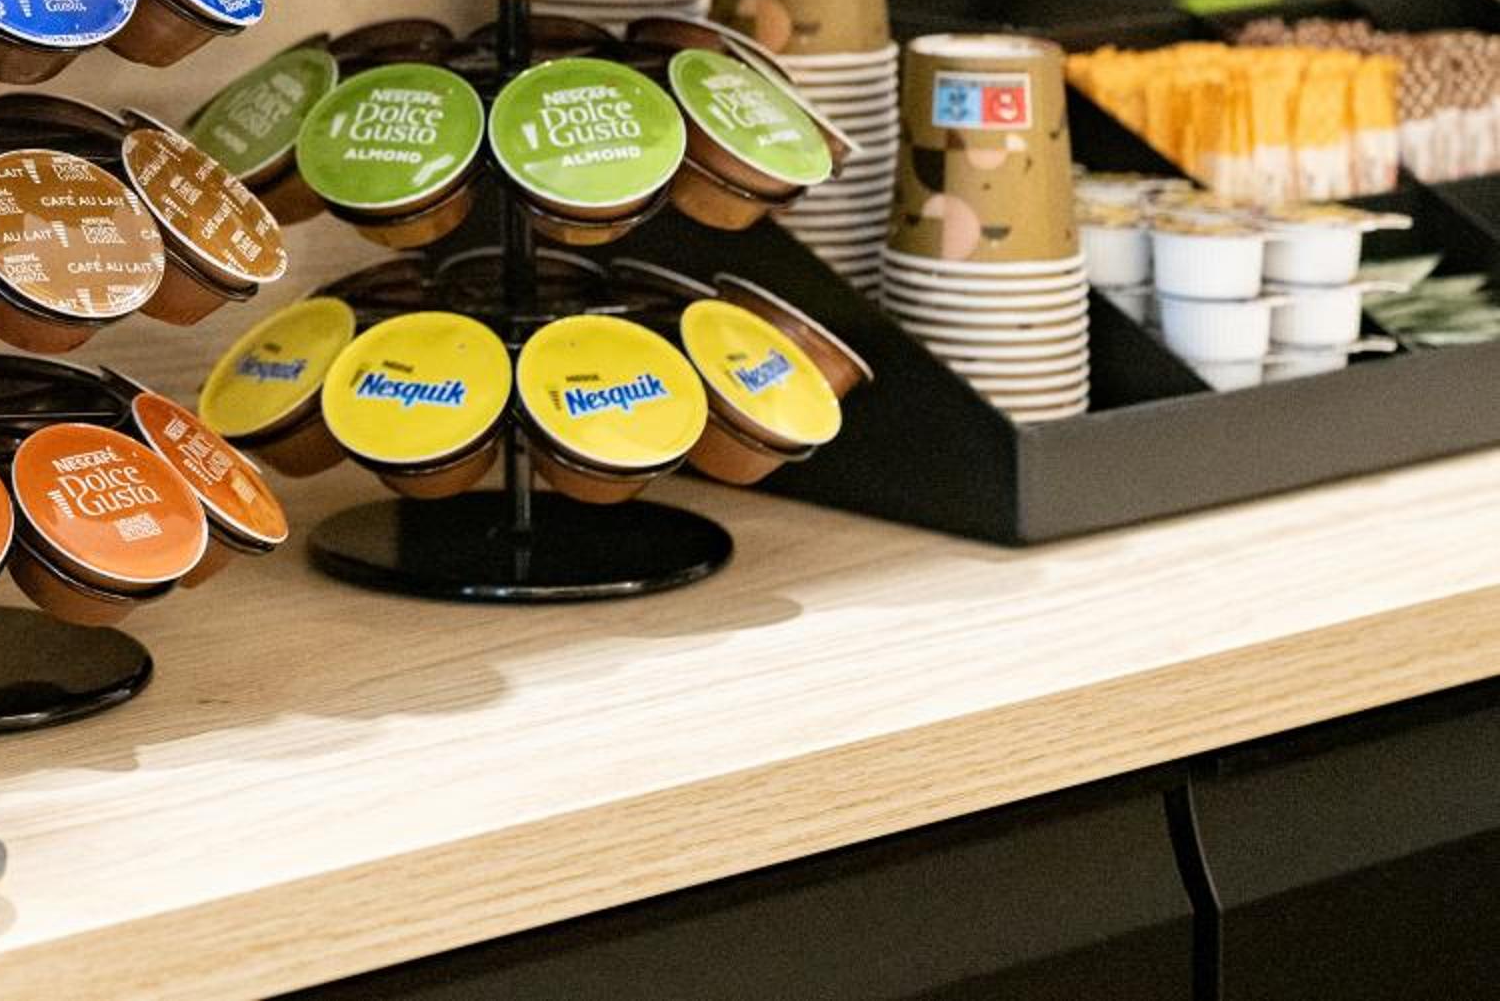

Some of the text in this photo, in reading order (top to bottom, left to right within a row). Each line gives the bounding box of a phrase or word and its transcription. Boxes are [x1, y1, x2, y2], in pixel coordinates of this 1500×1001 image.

[355, 101, 444, 128] Dolce
[541, 100, 633, 131] Dolce
[350, 123, 437, 145] Gusto
[549, 118, 640, 147] Gusto
[343, 148, 422, 164] ALMOND
[561, 145, 641, 167] ALMOND
[79, 196, 97, 206] AU
[3, 232, 21, 242] AU
[23, 229, 53, 241] LAIT
[106, 262, 124, 273] AU
[357, 372, 466, 406] Nesquik
[563, 374, 667, 416] Nesquik
[52, 446, 126, 474] NESCAFÉ
[57, 465, 146, 499] Dolce
[76, 484, 161, 516] Gusto
